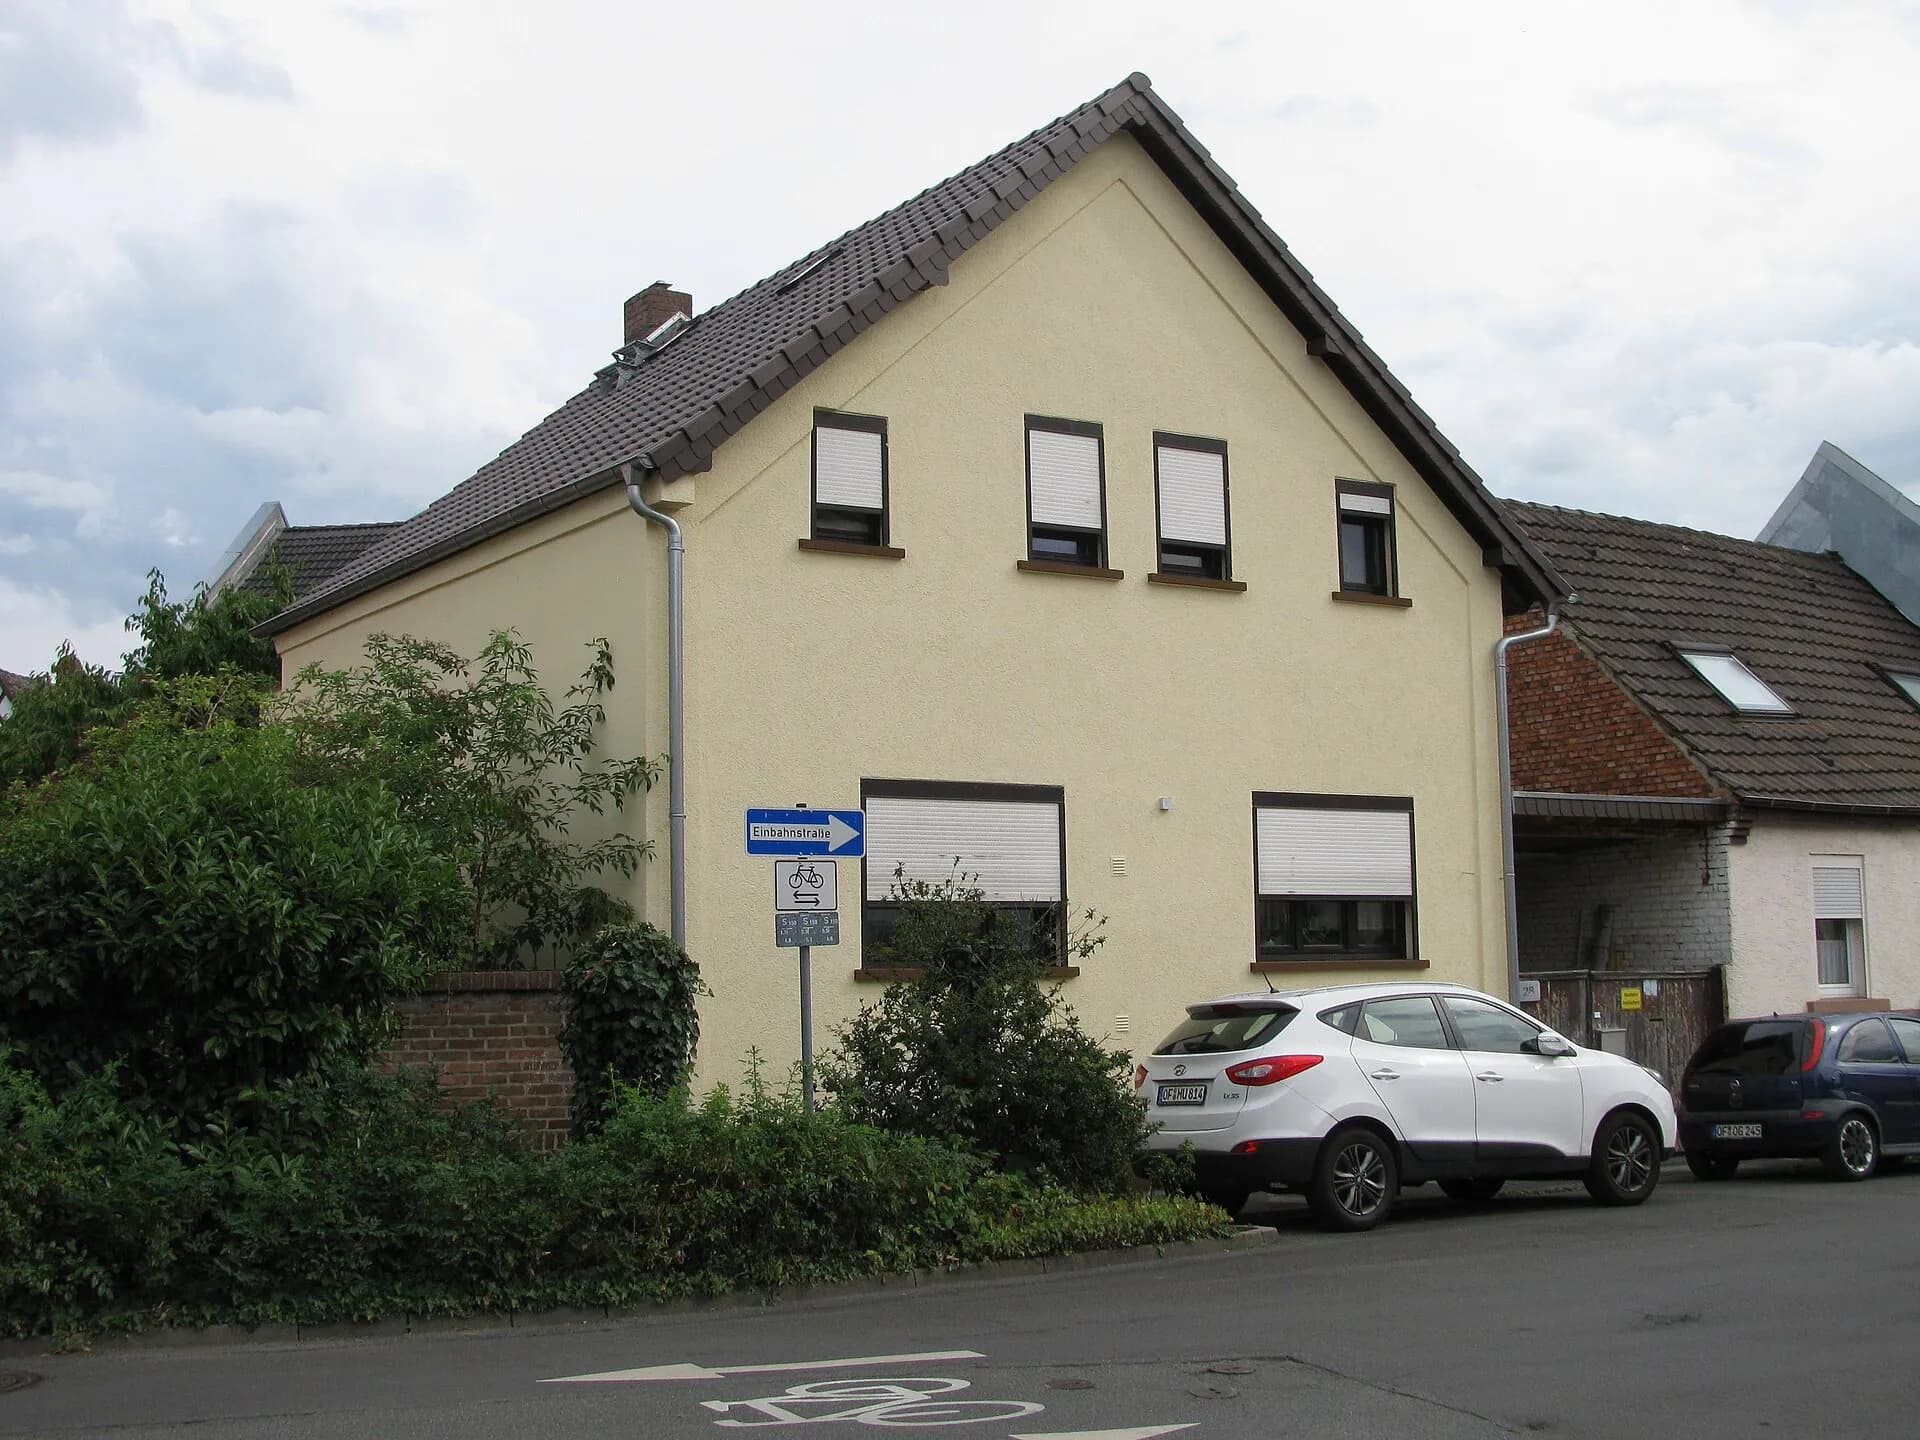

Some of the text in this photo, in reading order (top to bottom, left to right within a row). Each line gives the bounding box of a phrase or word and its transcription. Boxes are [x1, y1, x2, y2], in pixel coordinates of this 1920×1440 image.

[753, 826, 831, 839] Einbahnstraße
[1163, 1088, 1174, 1100] OF
[1716, 1126, 1727, 1137] OF
